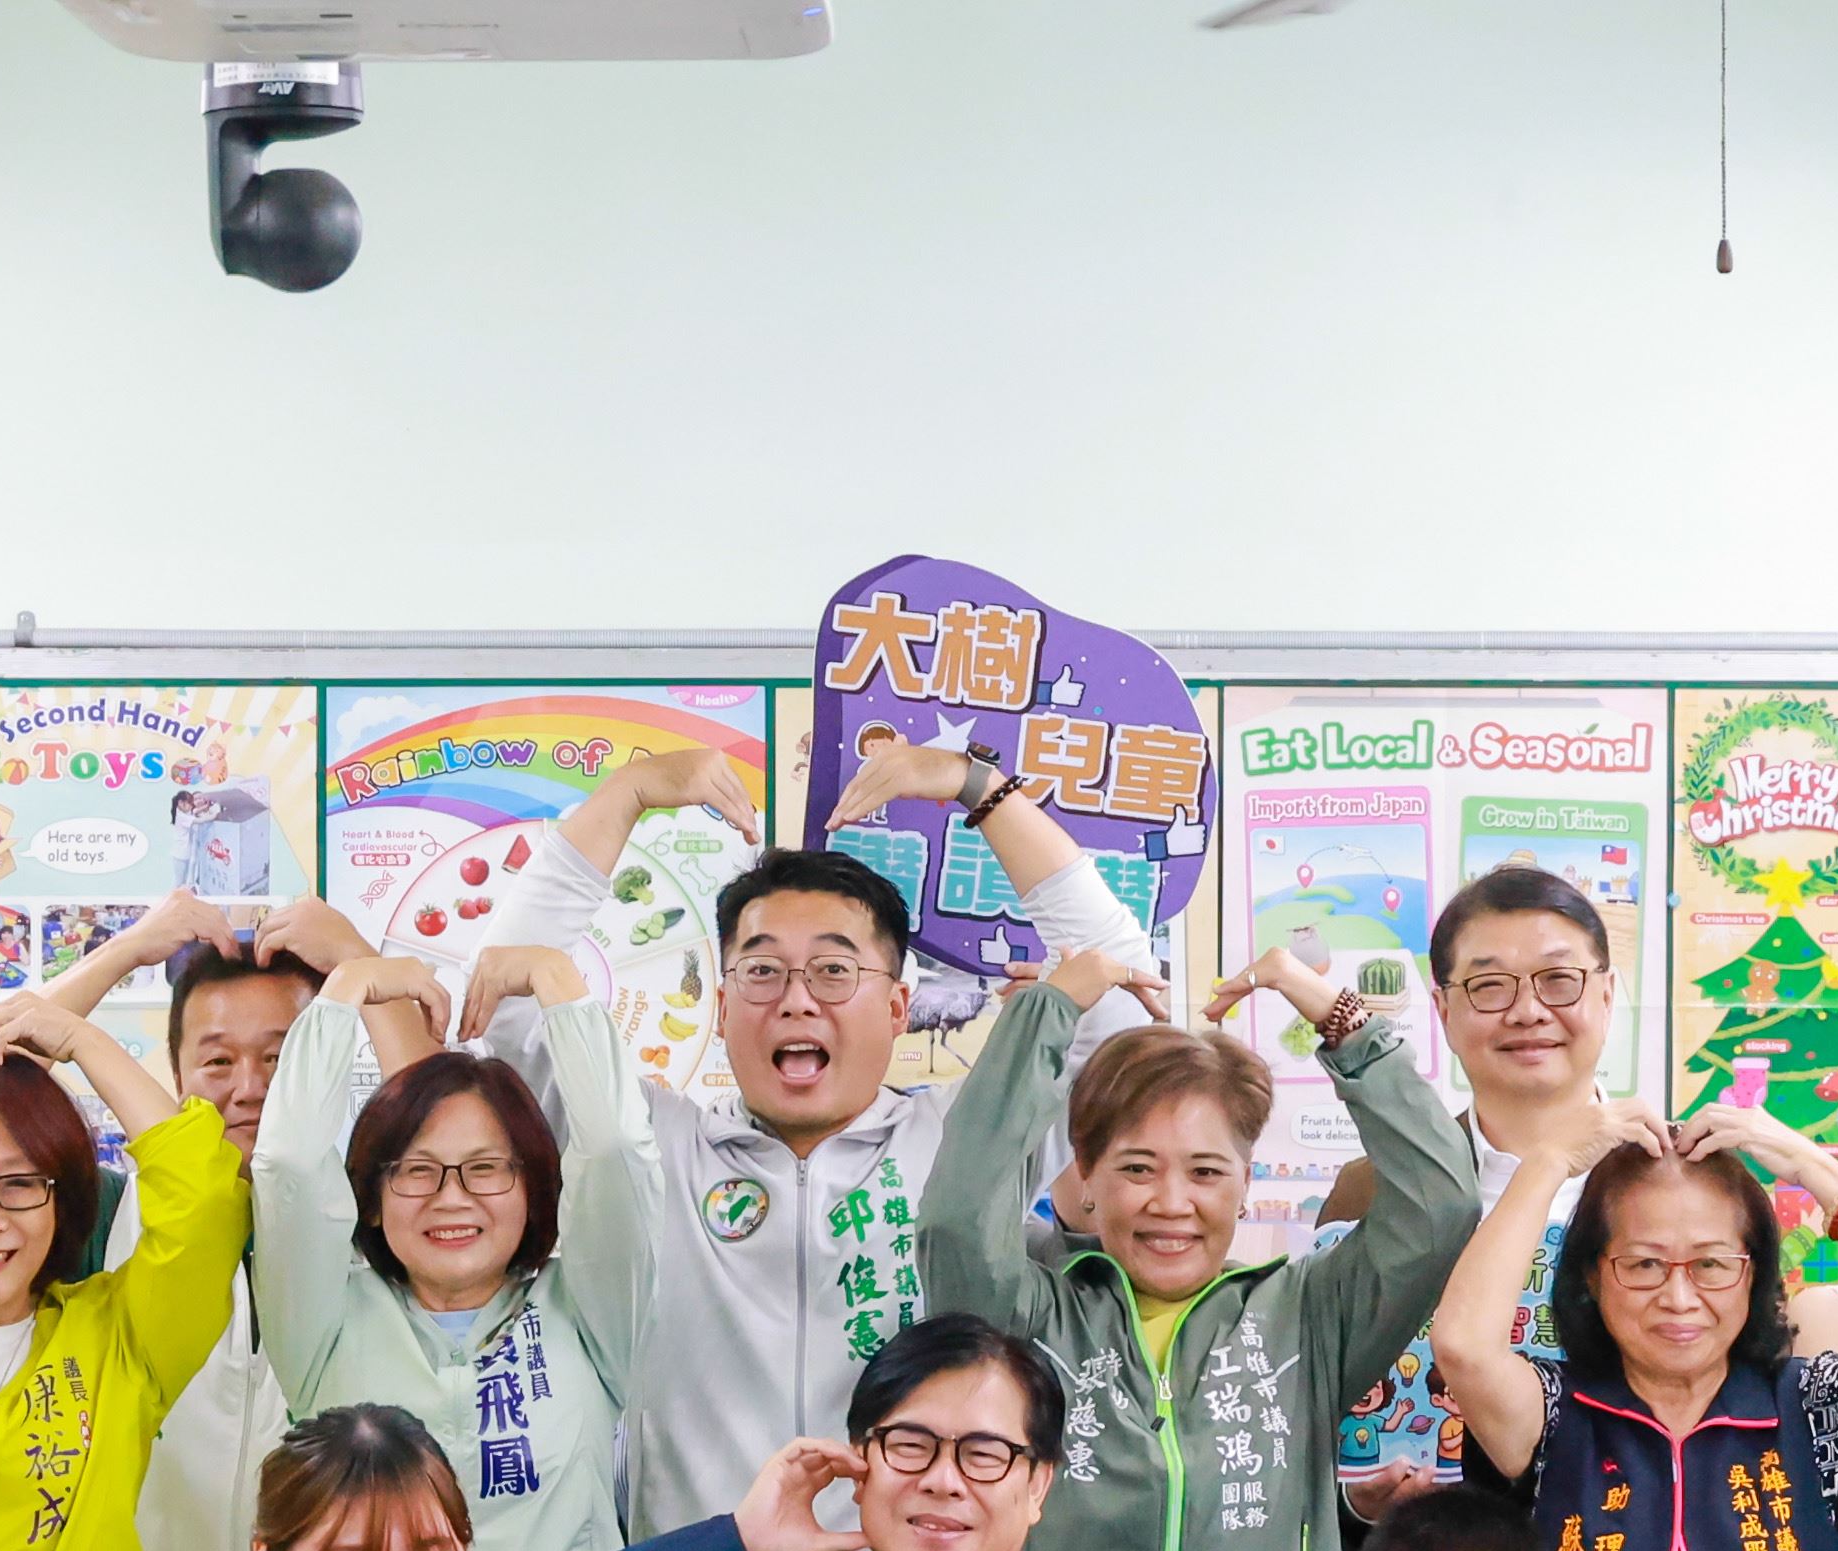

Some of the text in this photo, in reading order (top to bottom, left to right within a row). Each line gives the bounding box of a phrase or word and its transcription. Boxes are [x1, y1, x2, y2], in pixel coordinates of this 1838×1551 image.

[824, 592, 1044, 711] 大樹
[695, 693, 740, 706] Health
[116, 698, 206, 748] Hand
[1242, 720, 1653, 776] Eat Local & Seasonal
[31, 742, 165, 789] Toys
[336, 738, 612, 806] Rainbow of
[1015, 712, 1209, 823] 兒童
[1250, 796, 1425, 819] Import from Japan
[1480, 806, 1629, 831] Grow in Taiwan
[48, 830, 137, 848] Here are my
[342, 829, 415, 840] Heart & Blood
[48, 848, 108, 865] old toys.
[342, 842, 418, 853] Cardiovascular
[1694, 913, 1744, 924] Christmas
[898, 1051, 922, 1062] emu
[1301, 1115, 1355, 1126] Fruits fro
[1301, 1130, 1359, 1140] look delicio
[828, 1189, 888, 1362] 邱俊憲
